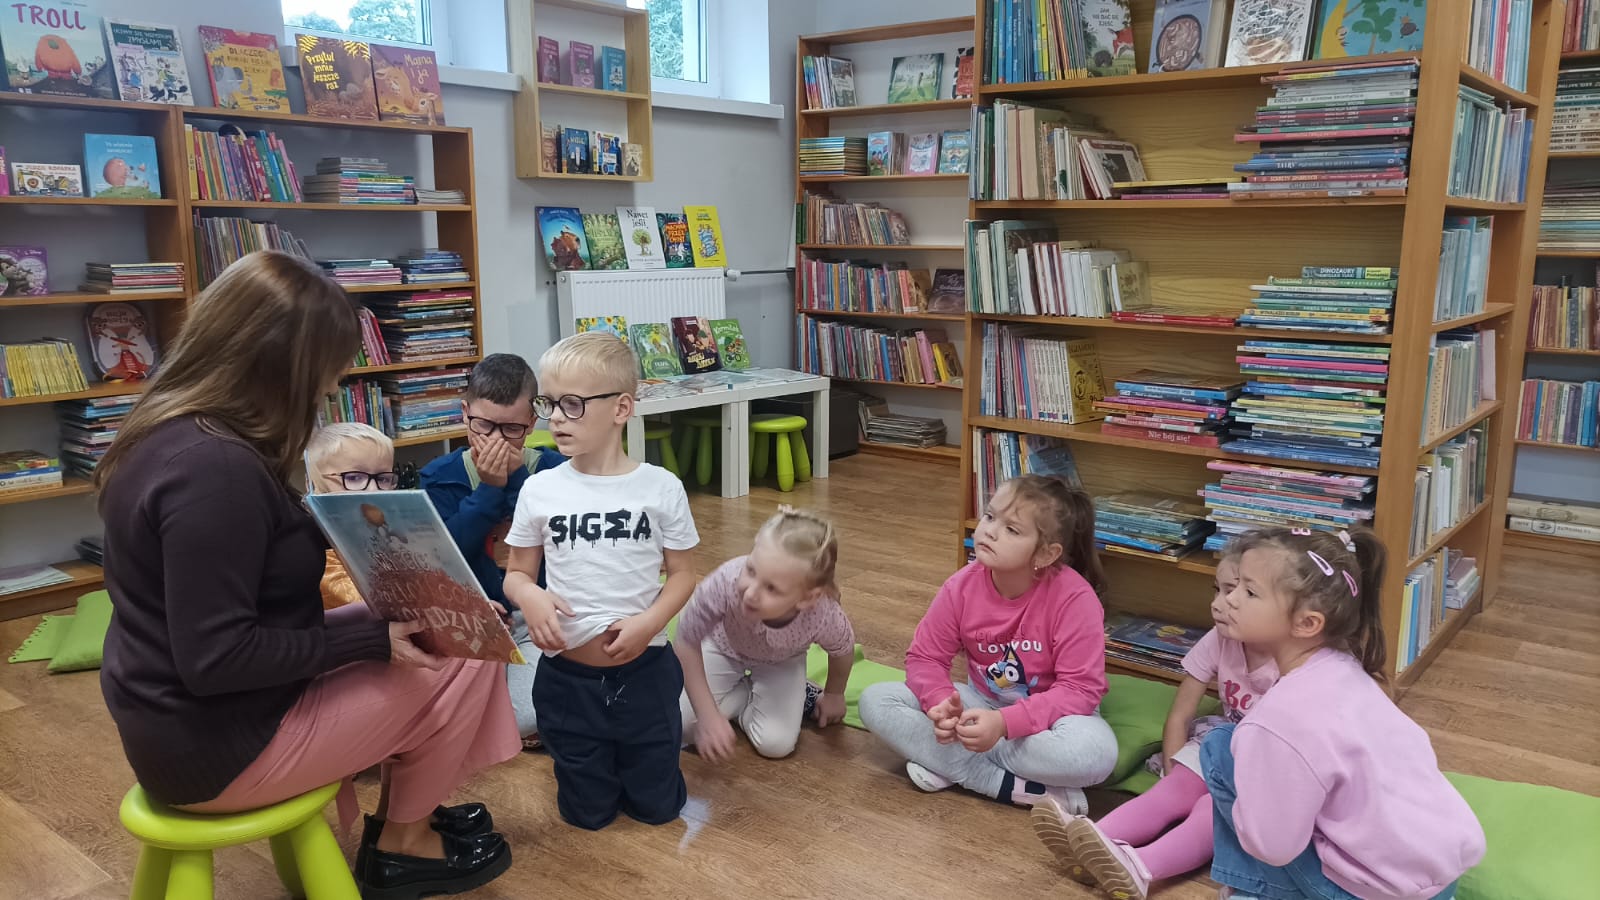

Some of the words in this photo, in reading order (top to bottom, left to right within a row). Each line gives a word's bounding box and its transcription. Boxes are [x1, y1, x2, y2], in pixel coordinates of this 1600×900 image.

[11, 3, 86, 30] TROLL
[305, 51, 335, 65] Przytul
[403, 54, 433, 66] Mama
[313, 72, 340, 83] jeszcze
[326, 81, 340, 90] raz
[1148, 430, 1162, 439] Nie
[1162, 430, 1175, 441] bój
[1011, 640, 1042, 652] YOU
